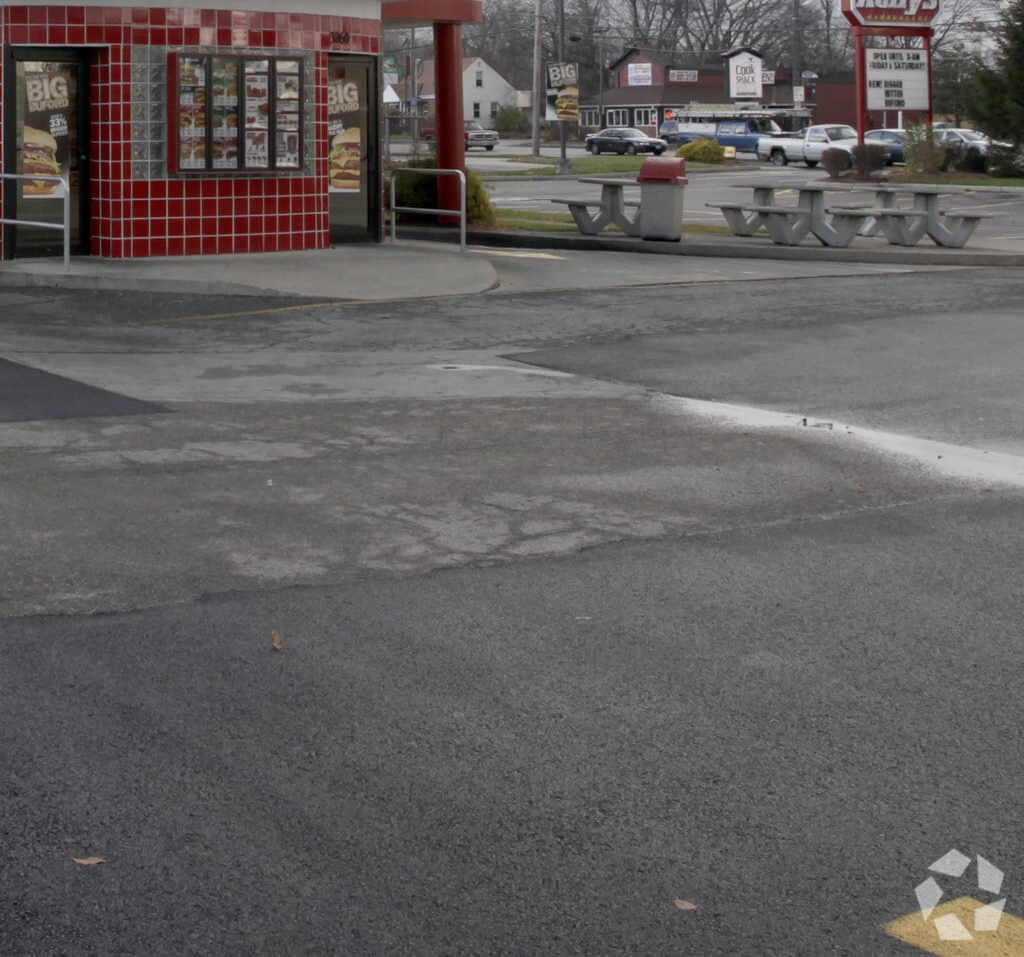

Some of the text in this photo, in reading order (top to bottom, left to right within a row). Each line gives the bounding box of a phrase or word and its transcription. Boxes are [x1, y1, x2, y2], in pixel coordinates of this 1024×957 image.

[888, 52, 904, 61] UNTIL
[736, 64, 756, 76] Cook
[869, 61, 888, 70] FRIDAY
[547, 64, 576, 81] BIG
[736, 75, 756, 84] SHACK
[26, 75, 68, 102] BIG
[328, 82, 359, 105] BIG
[28, 98, 69, 113] BUFORD
